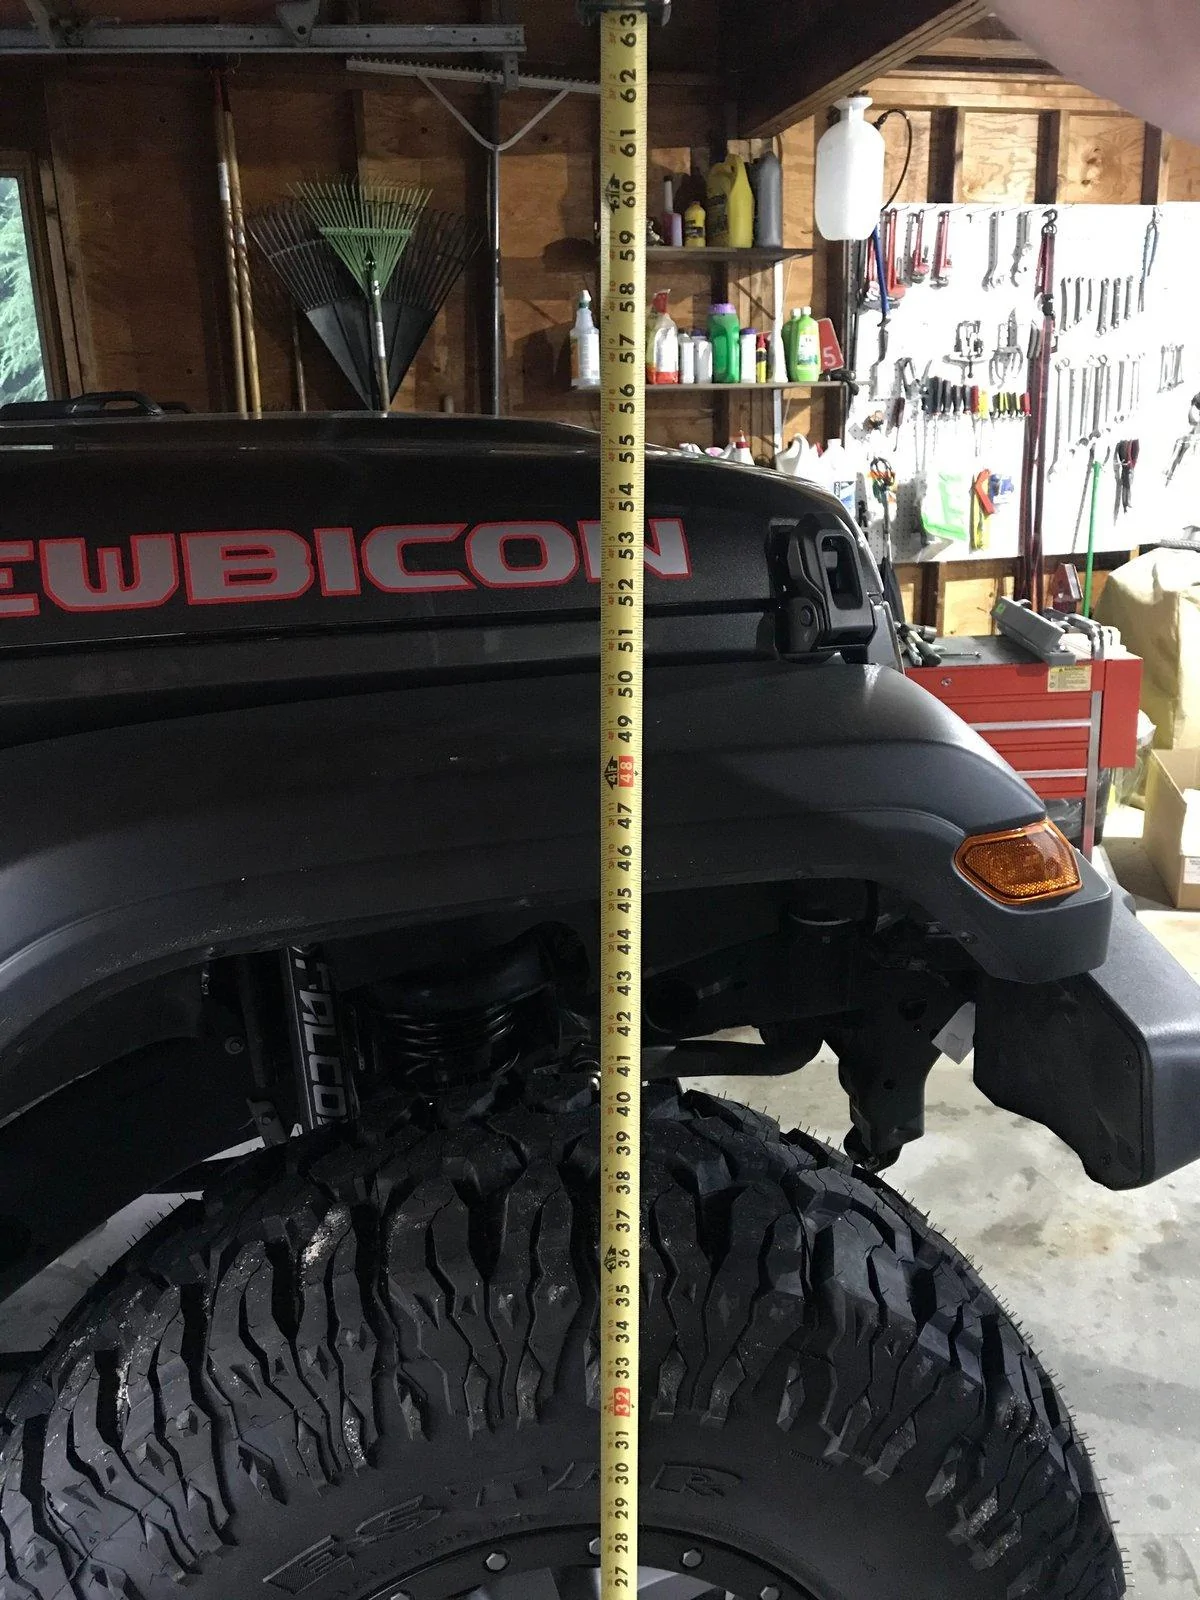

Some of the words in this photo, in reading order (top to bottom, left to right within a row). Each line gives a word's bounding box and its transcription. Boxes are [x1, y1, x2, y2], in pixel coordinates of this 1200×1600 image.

[620, 14, 636, 47] 63
[620, 69, 636, 103] 62
[620, 128, 636, 157] 61
[623, 181, 636, 208] 60
[619, 231, 635, 261] 59
[619, 282, 635, 313] 58
[619, 333, 635, 364] 57
[823, 346, 836, 366] 5
[619, 384, 635, 414] 56
[619, 435, 634, 463] 55
[619, 483, 634, 512] 54
[618, 532, 634, 560] 53
[618, 579, 634, 606] 52
[618, 629, 632, 652] 51
[618, 671, 632, 698] 50
[618, 715, 632, 742] 49
[621, 762, 632, 783] 48
[617, 802, 632, 829] 47
[617, 845, 632, 871] 46
[617, 888, 631, 913] 45
[617, 929, 631, 955] 44
[617, 971, 631, 996] 43
[617, 1011, 631, 1036] 42
[294, 958, 348, 1126] ALCO
[617, 1055, 630, 1077] 41
[617, 1092, 631, 1116] 40
[617, 1131, 630, 1156] 39
[616, 1171, 630, 1194] 38
[617, 1209, 630, 1232] 37
[618, 1249, 629, 1268] 36
[616, 1285, 629, 1307] 35
[616, 1321, 629, 1343] 34
[616, 1358, 629, 1379] 33
[617, 1392, 628, 1412] 32
[615, 1431, 628, 1449] 31
[615, 1463, 628, 1485] 30
[615, 1498, 628, 1519] 29
[615, 1533, 628, 1553] 28
[615, 1566, 627, 1587] 27
